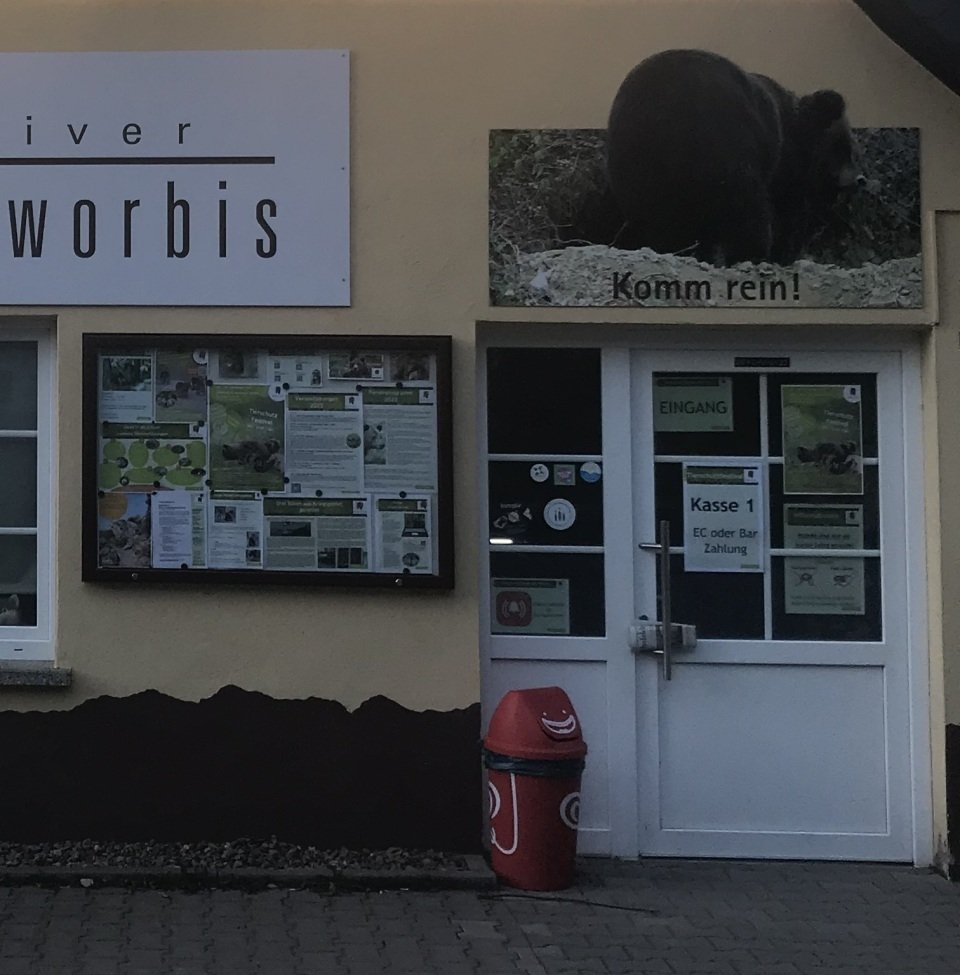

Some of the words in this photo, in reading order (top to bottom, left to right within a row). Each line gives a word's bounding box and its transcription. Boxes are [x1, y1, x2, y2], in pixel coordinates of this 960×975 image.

[7, 180, 278, 259] worbis
[612, 271, 712, 301] Komm
[726, 272, 801, 301] rein!
[659, 400, 728, 415] EINGANG
[690, 497, 739, 513] Kasse
[746, 498, 754, 513] 1
[693, 527, 708, 538] EC
[710, 528, 737, 539] oder
[739, 528, 759, 539] Bar
[704, 542, 748, 557] Zahlung
